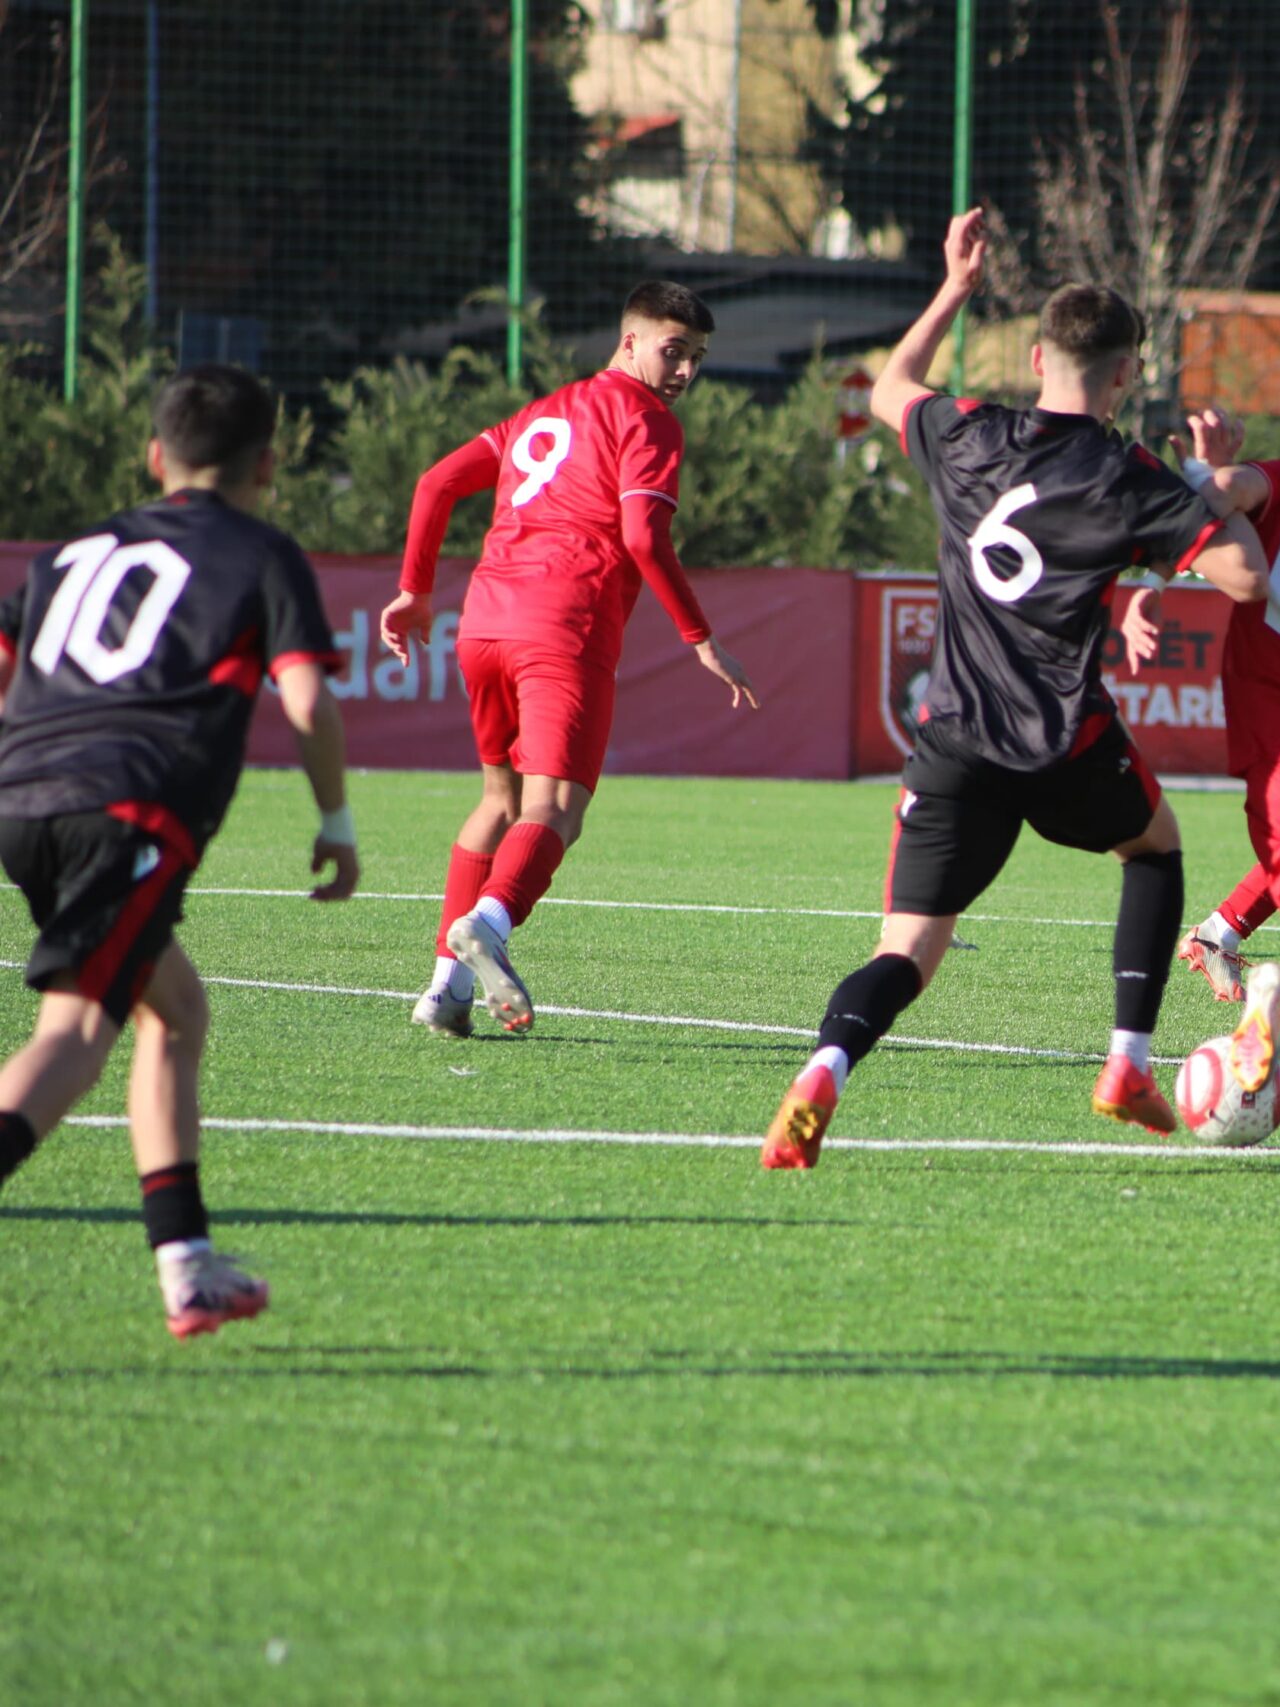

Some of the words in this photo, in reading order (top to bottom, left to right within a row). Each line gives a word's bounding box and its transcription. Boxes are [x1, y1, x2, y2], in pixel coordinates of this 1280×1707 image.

[511, 416, 571, 507] 9
[966, 482, 1043, 602] 6
[30, 532, 192, 685] 10
